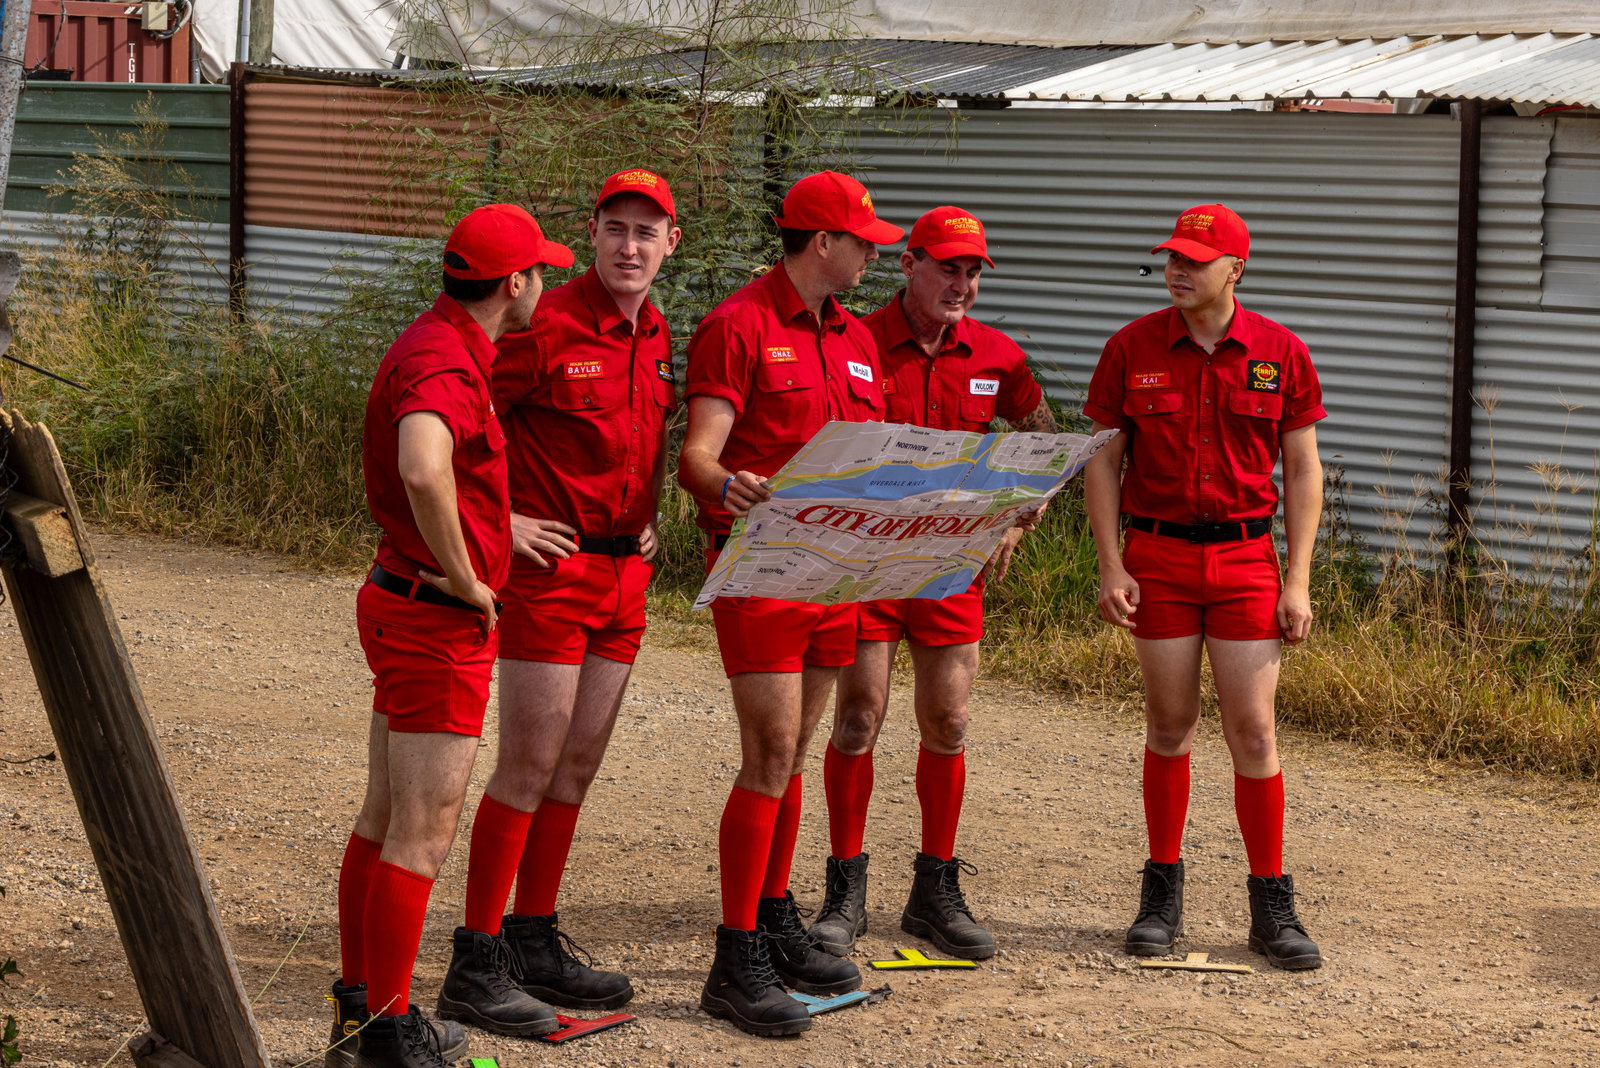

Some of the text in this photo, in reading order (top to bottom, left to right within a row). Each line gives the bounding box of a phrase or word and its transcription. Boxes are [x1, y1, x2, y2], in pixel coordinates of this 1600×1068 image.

[567, 365, 601, 374] BAYLEY
[852, 364, 869, 377] Mobil
[1253, 367, 1278, 376] PENRITE
[1253, 381, 1267, 389] 100
[896, 441, 929, 452] NORTHVIEW
[796, 504, 878, 533] CITY
[869, 517, 912, 537] OF
